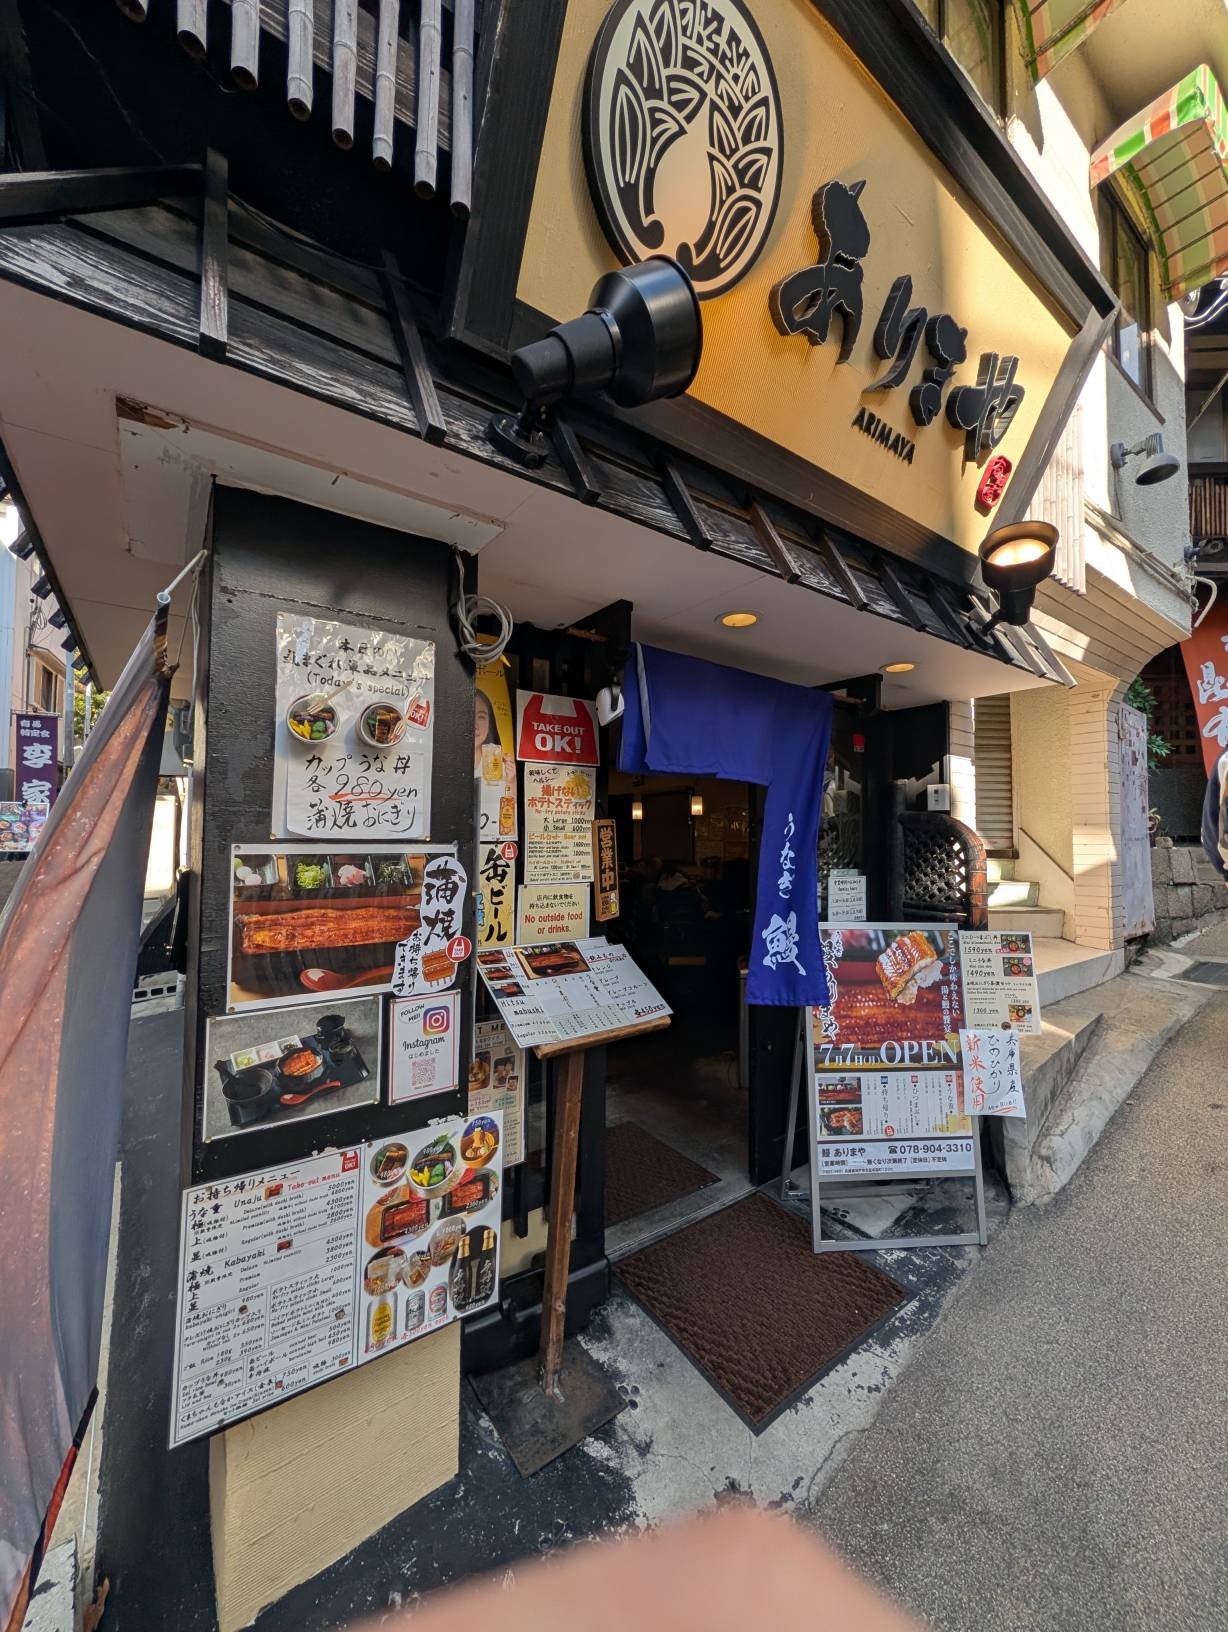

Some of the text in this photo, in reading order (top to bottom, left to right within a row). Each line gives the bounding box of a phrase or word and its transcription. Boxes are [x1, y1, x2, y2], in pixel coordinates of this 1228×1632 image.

[852, 407, 915, 464] ARIMAYA
[367, 682, 411, 698] special)
[532, 721, 585, 736] TAKE OUT
[534, 733, 582, 754] OK!
[304, 773, 418, 806] 各 980yen
[528, 796, 592, 810] ポテトスティック
[600, 826, 615, 891] 営業中
[778, 812, 796, 899] うなぎ
[423, 860, 466, 946] 蒲焼
[480, 848, 511, 942] 缶ビール
[524, 911, 583, 924] No outside food
[537, 924, 572, 935] or drinks.
[762, 911, 807, 976] 鰻
[964, 946, 993, 954] 1590yen
[393, 943, 409, 994] できます
[408, 930, 422, 994] お持ち帰り
[400, 1003, 425, 1018] FOLLOW
[501, 999, 525, 1009] Hitsu
[514, 1006, 545, 1016] mabushi
[402, 1036, 446, 1052] Instagram
[880, 1040, 959, 1065] OPEN
[882, 1088, 890, 1118] 持ち帰り
[912, 1087, 921, 1123] ひつまぶし
[833, 1147, 866, 1158] ありまや
[193, 1170, 298, 1203] お持ち帰りメニュー
[327, 1179, 354, 1190] 5000yen
[189, 1195, 261, 1220] うな重 Unaju
[186, 1249, 264, 1282] 蒲焼 Kabayaki
[187, 1291, 199, 1302] 上
